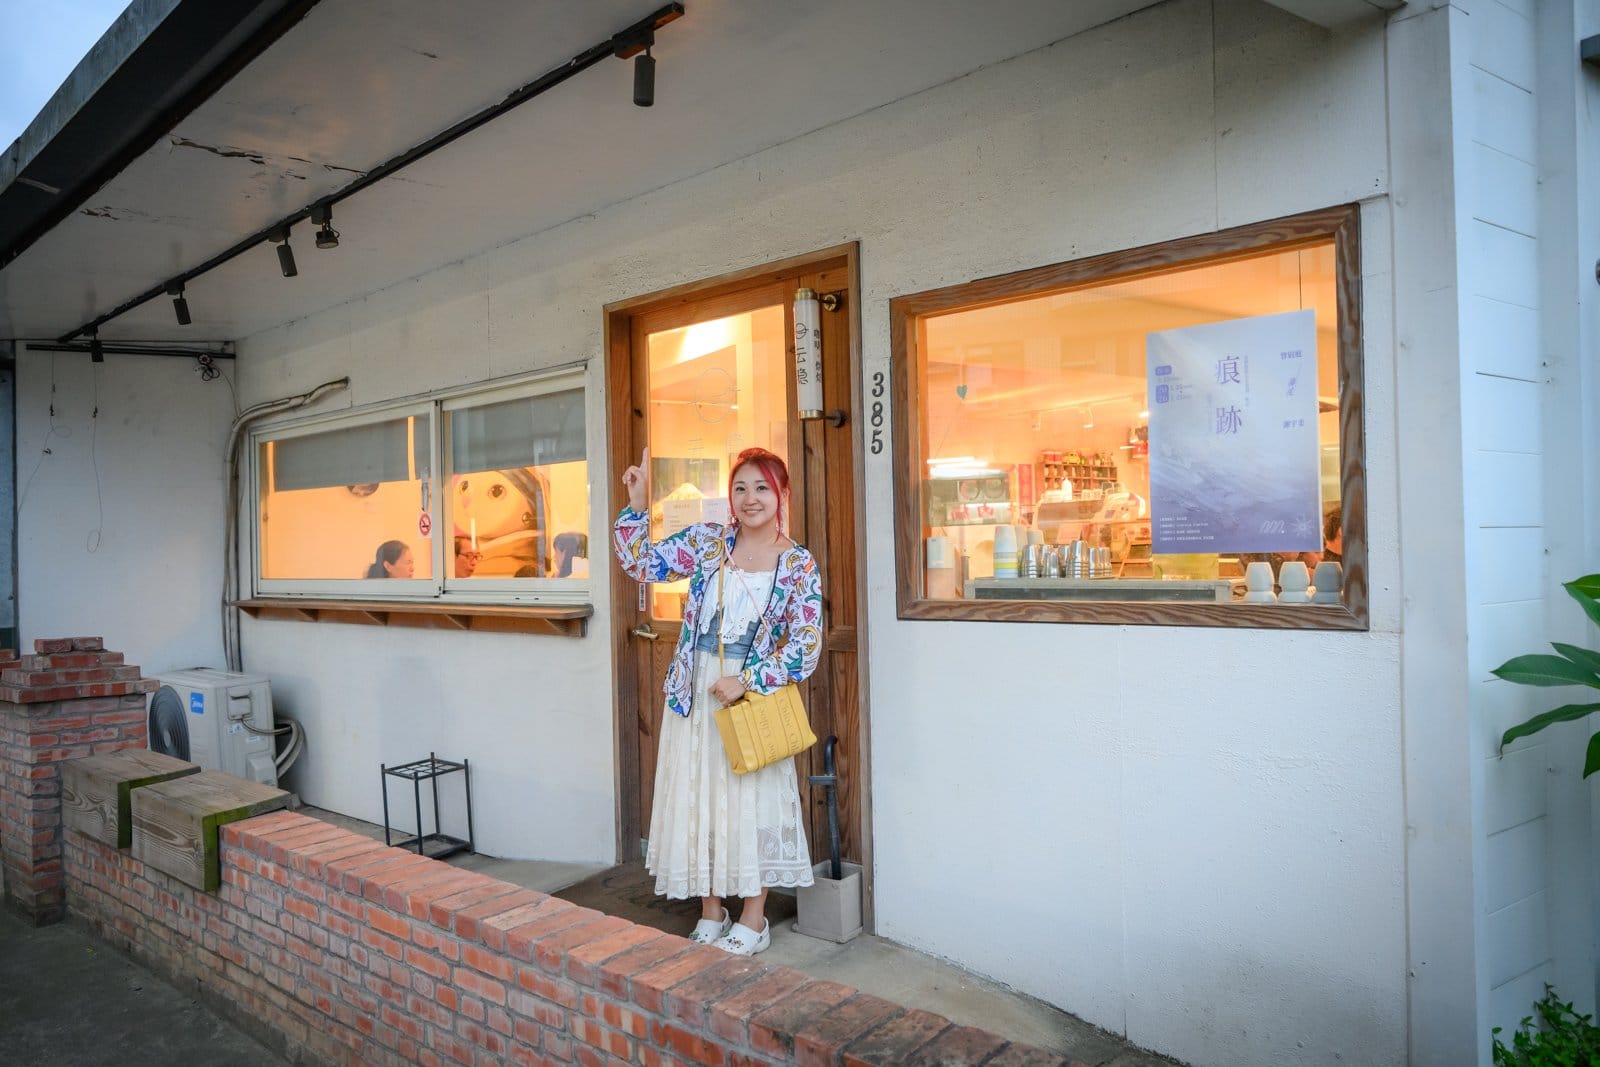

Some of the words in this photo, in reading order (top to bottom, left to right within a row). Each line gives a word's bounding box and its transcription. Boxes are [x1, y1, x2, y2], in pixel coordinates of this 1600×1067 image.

[871, 371, 884, 455] 385
[1215, 355, 1242, 435] 痕跡
[789, 732, 801, 754] Chl
